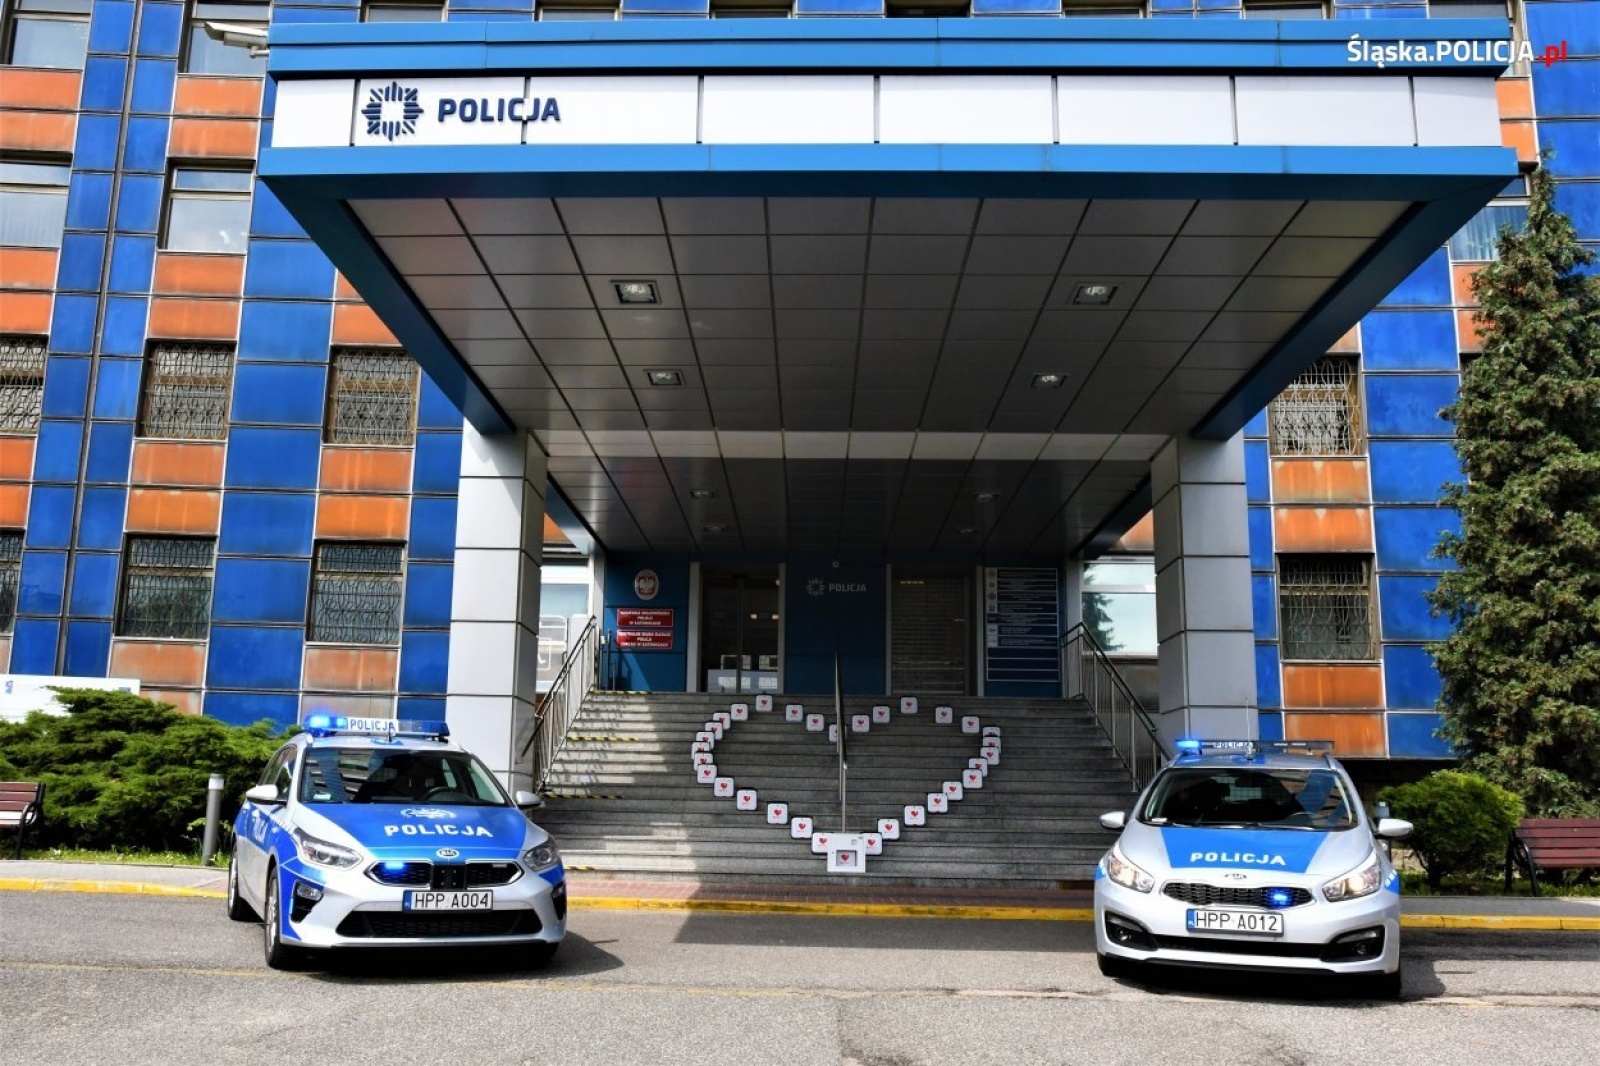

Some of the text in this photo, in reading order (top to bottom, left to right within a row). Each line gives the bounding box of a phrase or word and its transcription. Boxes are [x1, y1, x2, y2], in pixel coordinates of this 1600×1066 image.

[438, 97, 561, 123] POLICJA
[828, 582, 867, 592] POLICJA
[350, 718, 396, 731] POLICJA
[1213, 741, 1254, 749] POLICJA
[384, 824, 494, 837] POLICJA
[1190, 852, 1287, 865] POLICJA
[415, 893, 489, 908] HPP A004
[1196, 912, 1231, 928] HPP
[1238, 914, 1277, 931] A012
